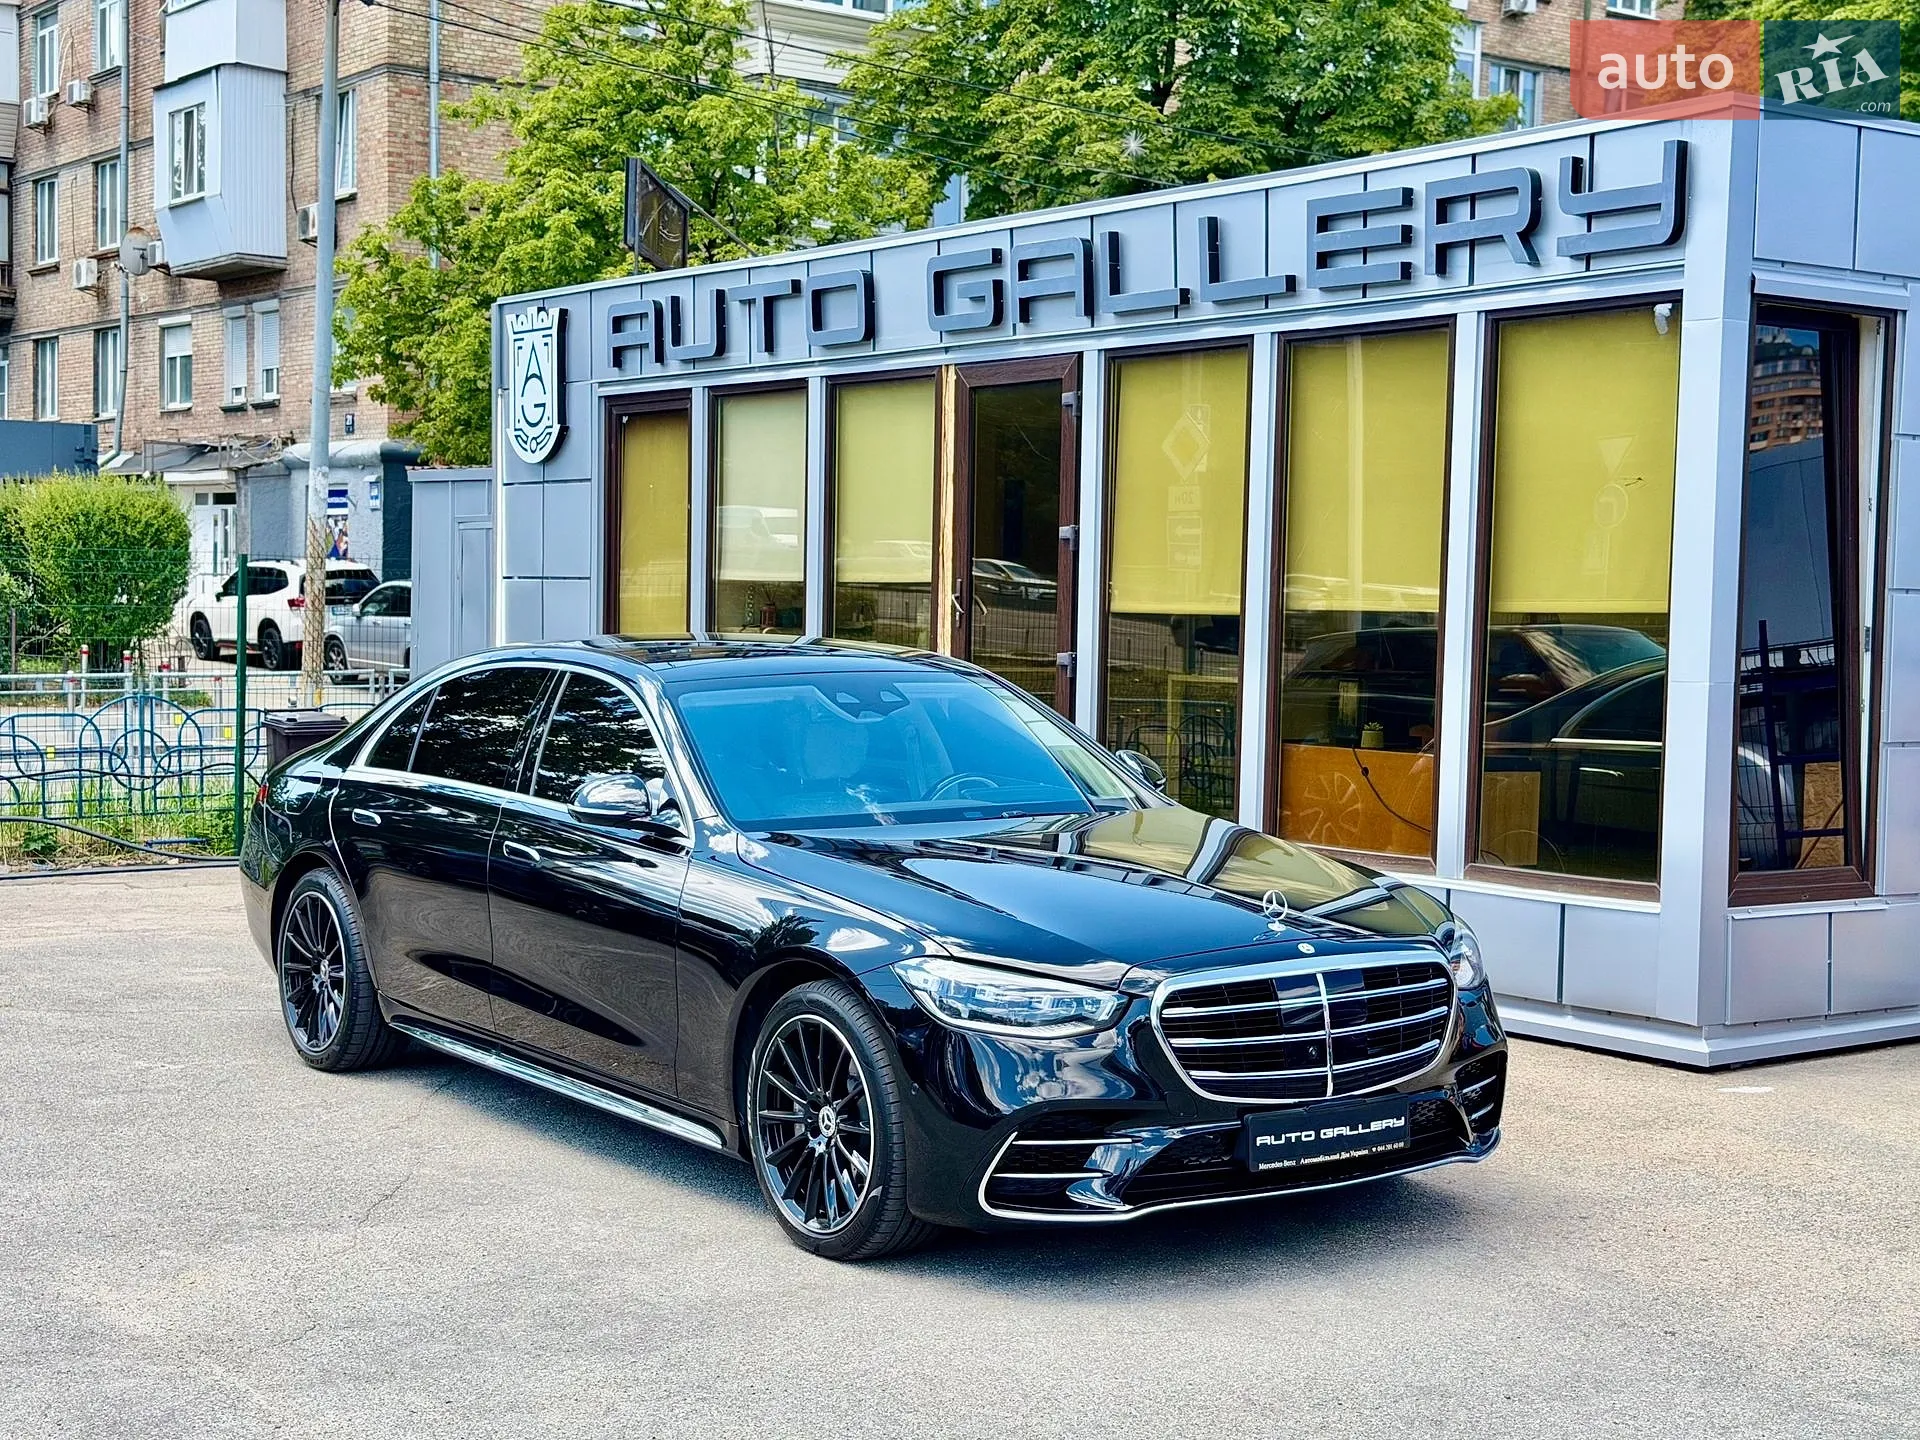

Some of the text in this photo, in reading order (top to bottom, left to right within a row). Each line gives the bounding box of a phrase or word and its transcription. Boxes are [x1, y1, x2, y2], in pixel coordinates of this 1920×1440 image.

[607, 139, 1688, 368] AUTO GALLERY
[1256, 1116, 1405, 1147] AUTO GALLERY
